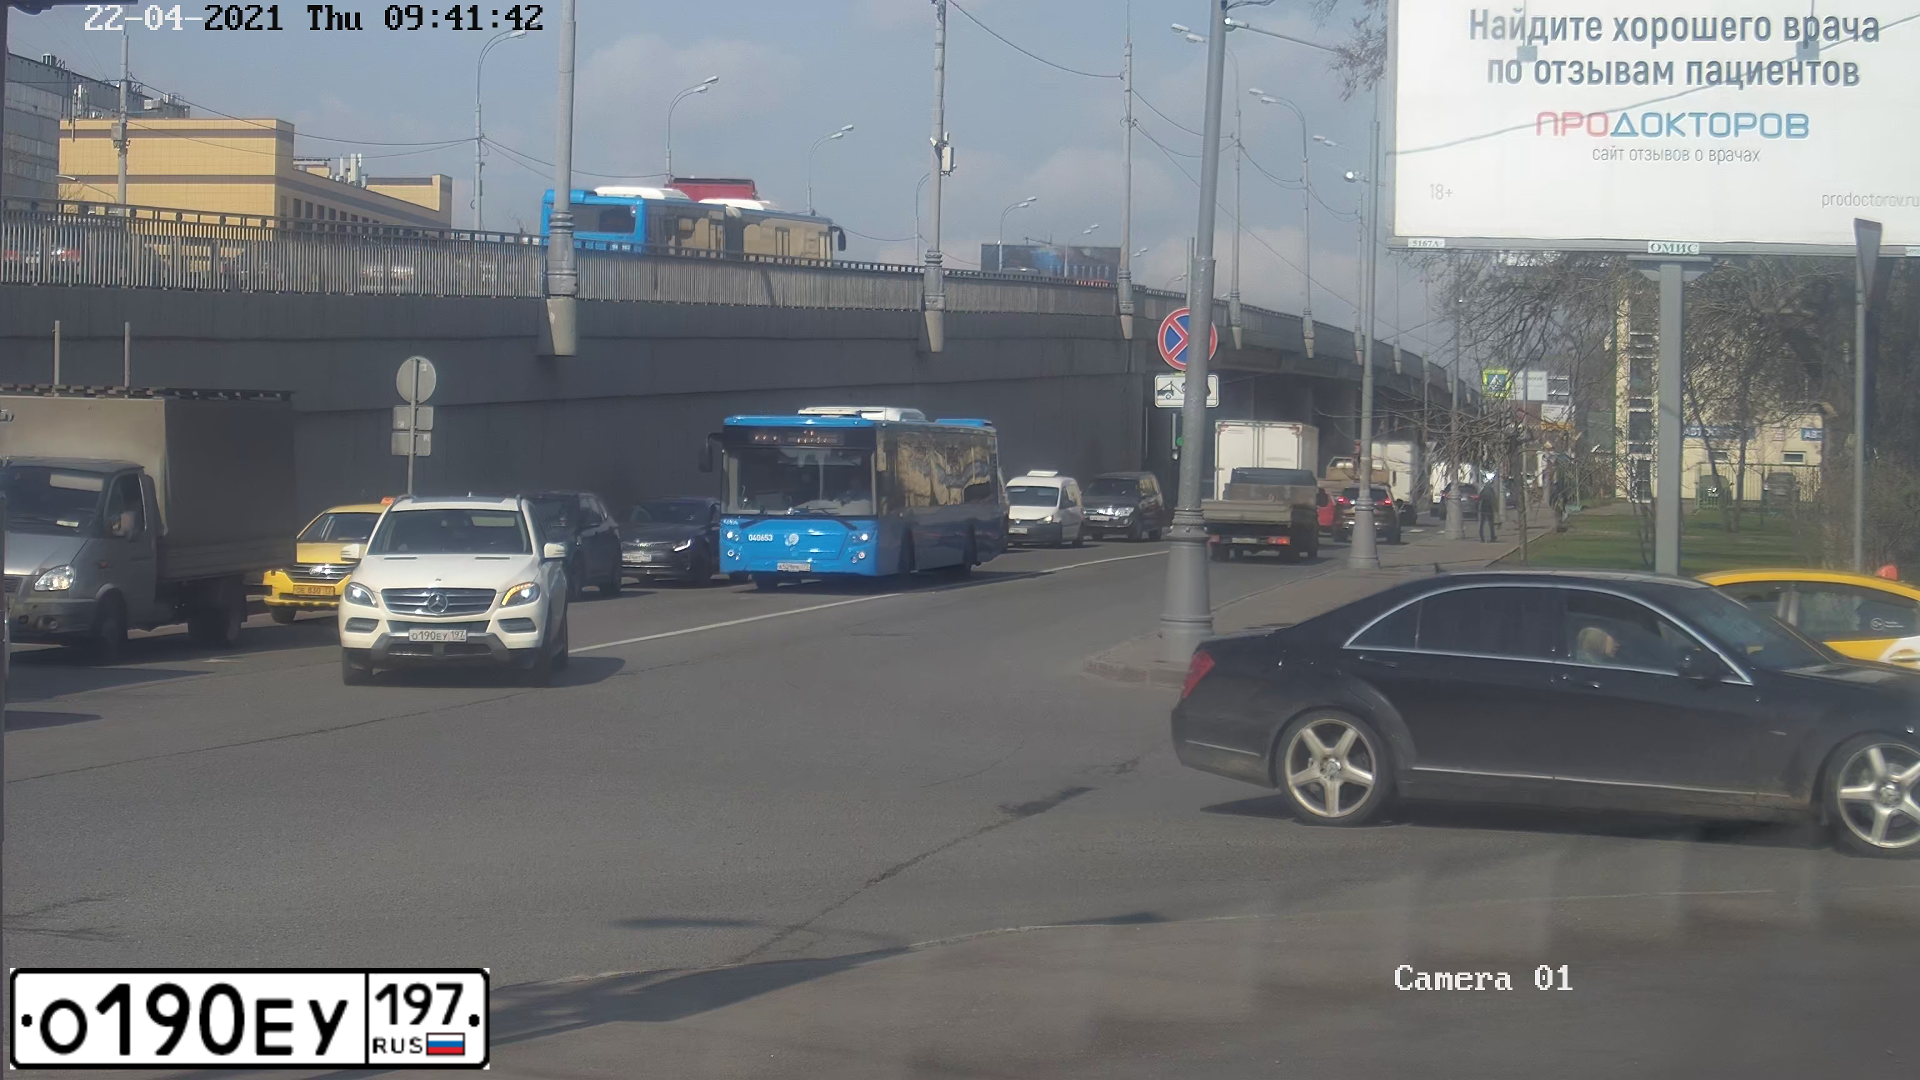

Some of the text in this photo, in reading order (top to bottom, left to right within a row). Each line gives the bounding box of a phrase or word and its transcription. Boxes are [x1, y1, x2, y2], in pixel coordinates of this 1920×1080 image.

[1469, 7, 1880, 50] Найдите хорошего врача
[1487, 59, 1860, 91] по отзывам пациентов
[1535, 111, 1810, 140] ПРОДОКТОРОВ
[1591, 145, 1761, 166] сайт отзывов о врачах
[1429, 182, 1453, 200] 18+
[1649, 242, 1698, 253] ОМИС
[748, 533, 773, 542] 040653
